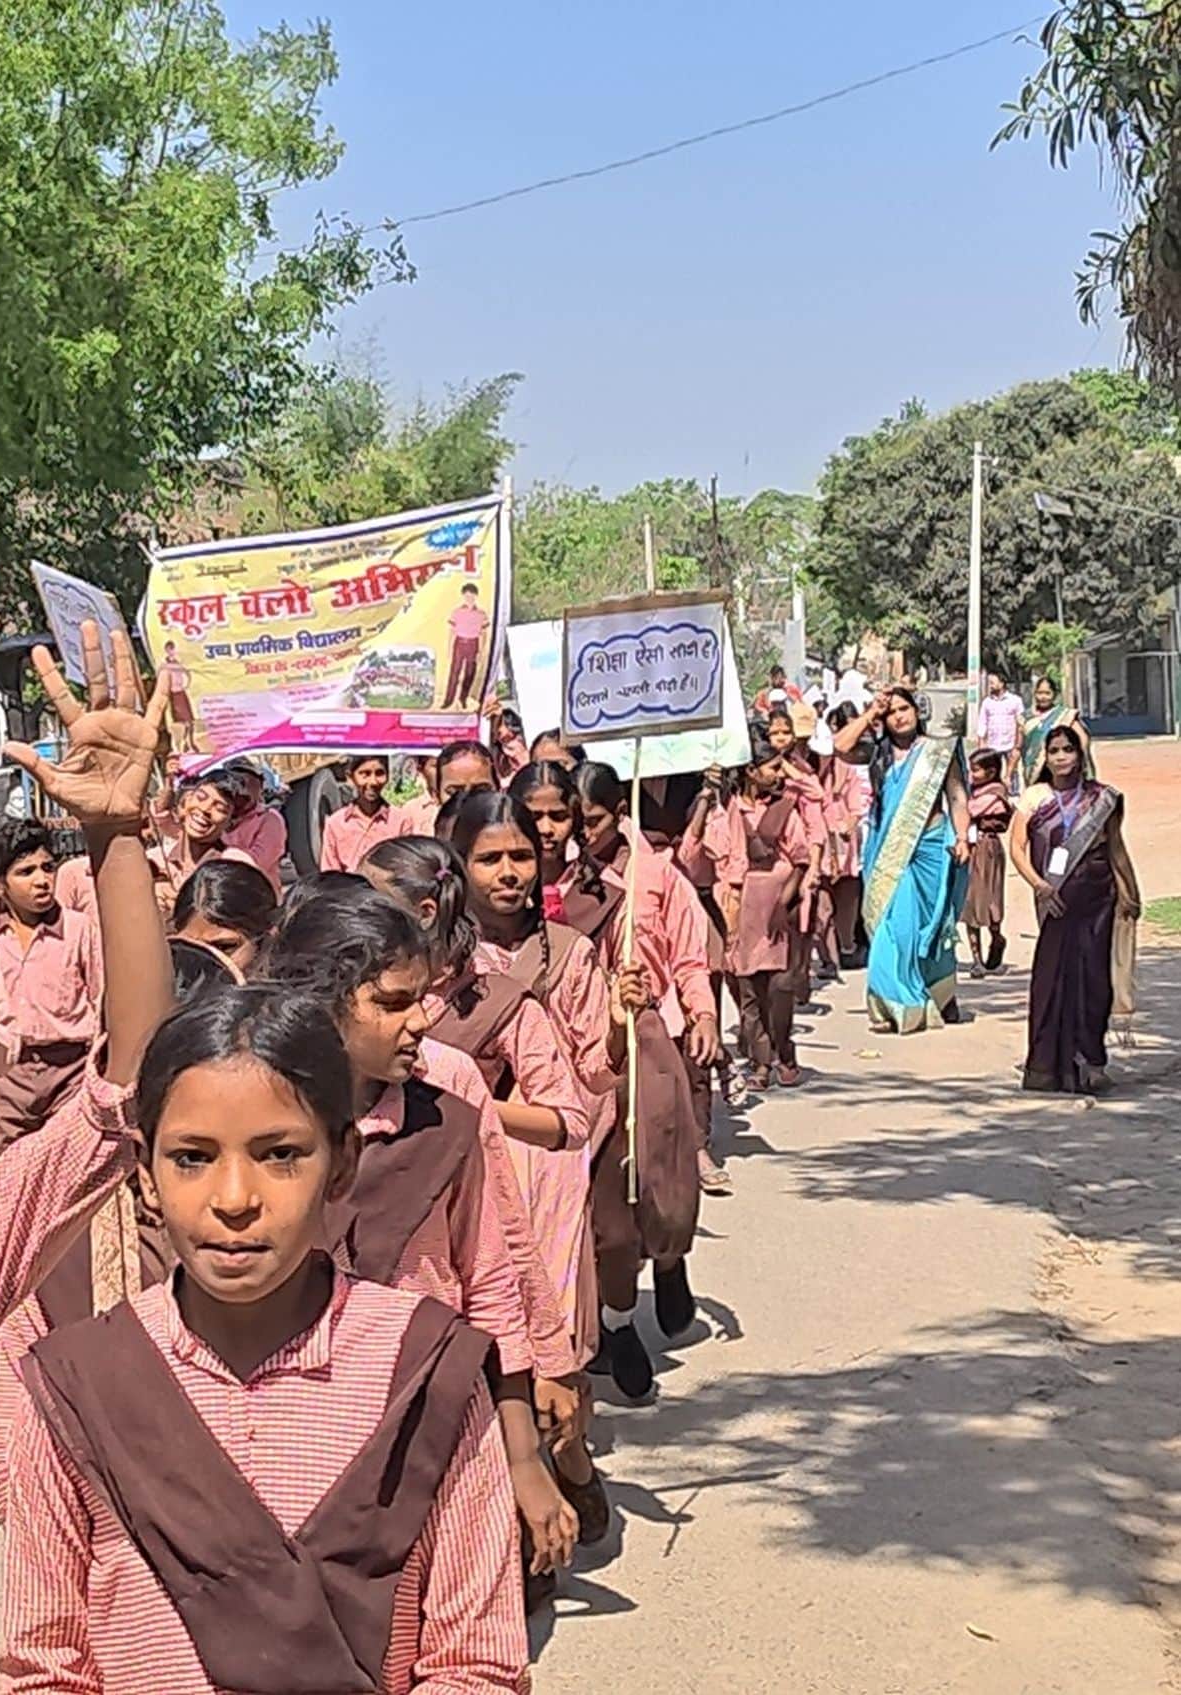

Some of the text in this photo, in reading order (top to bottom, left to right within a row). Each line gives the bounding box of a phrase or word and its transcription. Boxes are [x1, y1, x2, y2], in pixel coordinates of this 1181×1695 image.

[156, 594, 227, 636] स्कूल
[239, 579, 312, 619] चलो
[235, 636, 293, 660] प्राथमिक
[297, 627, 362, 652] विद्यालय
[588, 650, 627, 673] शिक्षा
